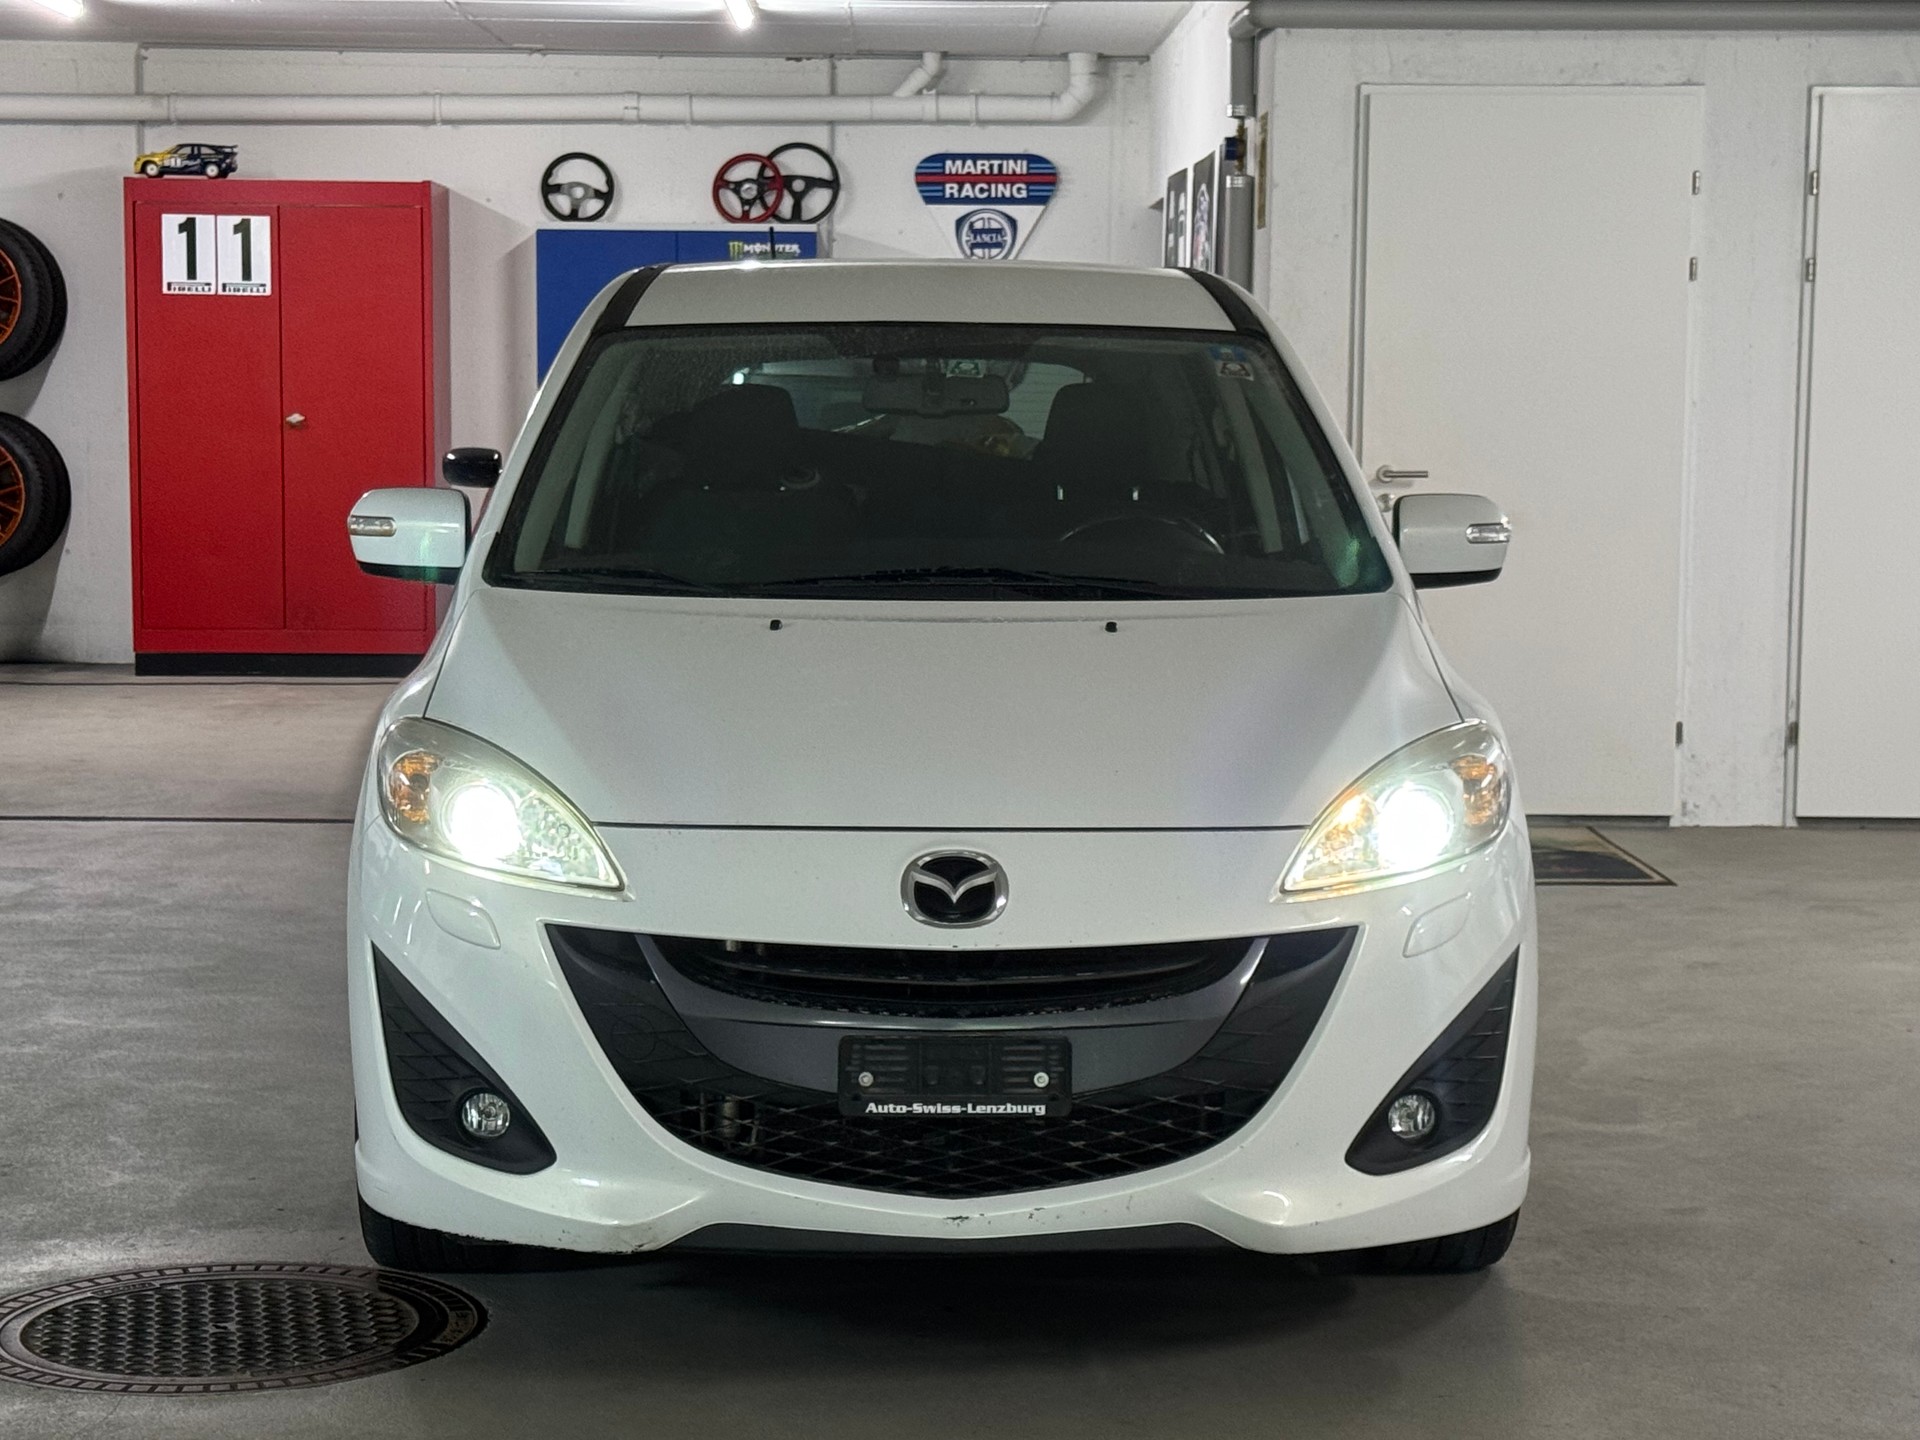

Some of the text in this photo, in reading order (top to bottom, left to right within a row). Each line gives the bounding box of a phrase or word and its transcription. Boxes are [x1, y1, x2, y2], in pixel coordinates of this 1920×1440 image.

[945, 160, 1027, 174] MARTINI
[945, 183, 1027, 198] RACING
[865, 1102, 1046, 1115] Auto-Swiss-Lenzburg
